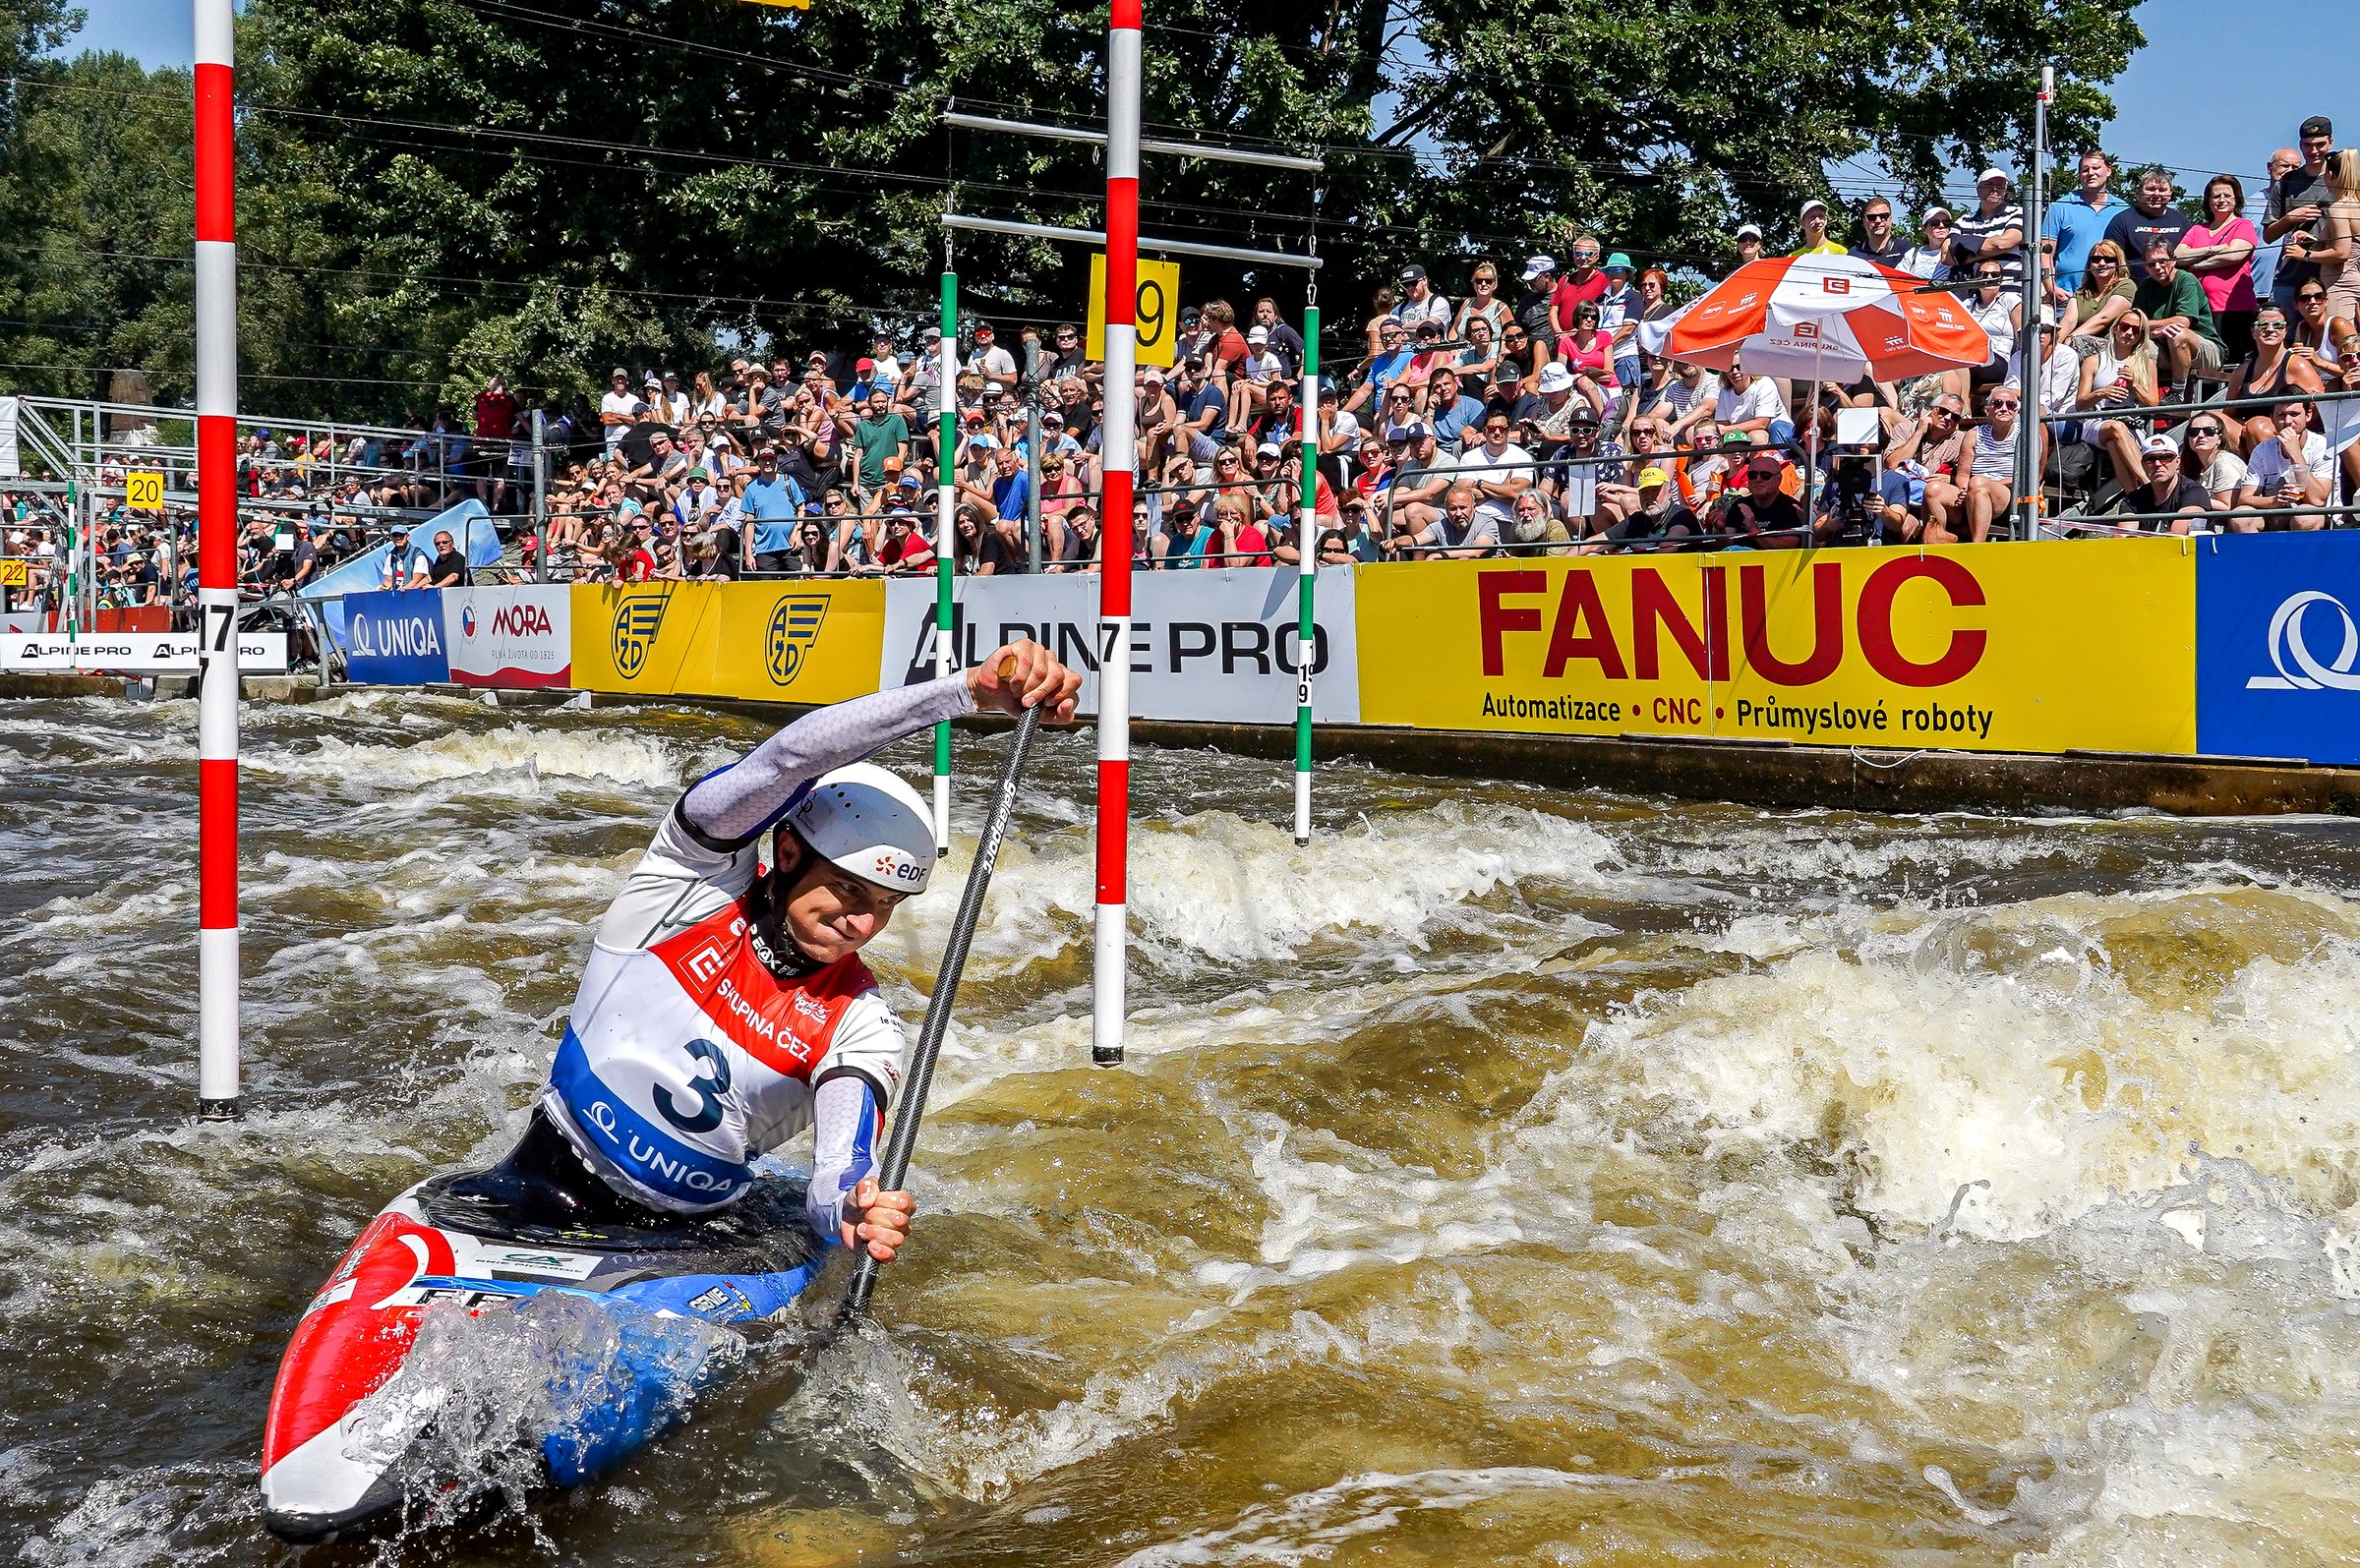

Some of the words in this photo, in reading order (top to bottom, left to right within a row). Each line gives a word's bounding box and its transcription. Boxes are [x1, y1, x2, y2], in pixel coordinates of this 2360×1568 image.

[1136, 279, 1165, 347] 9
[132, 479, 158, 502] 20
[3, 564, 24, 581] 22
[200, 604, 234, 651] 17
[378, 617, 441, 657] UNIQA
[492, 605, 553, 637] MORA
[1477, 553, 1987, 687] FANUC
[94, 646, 132, 656] PRO
[152, 644, 200, 659] ALPI
[238, 646, 266, 656] RO
[1168, 621, 1329, 675] PRO
[1482, 692, 1621, 722] Automatizace
[1653, 697, 1702, 726] CNC
[1738, 694, 1888, 735] Průmyslové
[1902, 702, 1994, 739] roboty
[716, 978, 775, 1041] SKUPINA
[776, 1025, 812, 1063] ČEZ
[653, 1038, 732, 1133] 3
[628, 1134, 733, 1192] UNIQA
